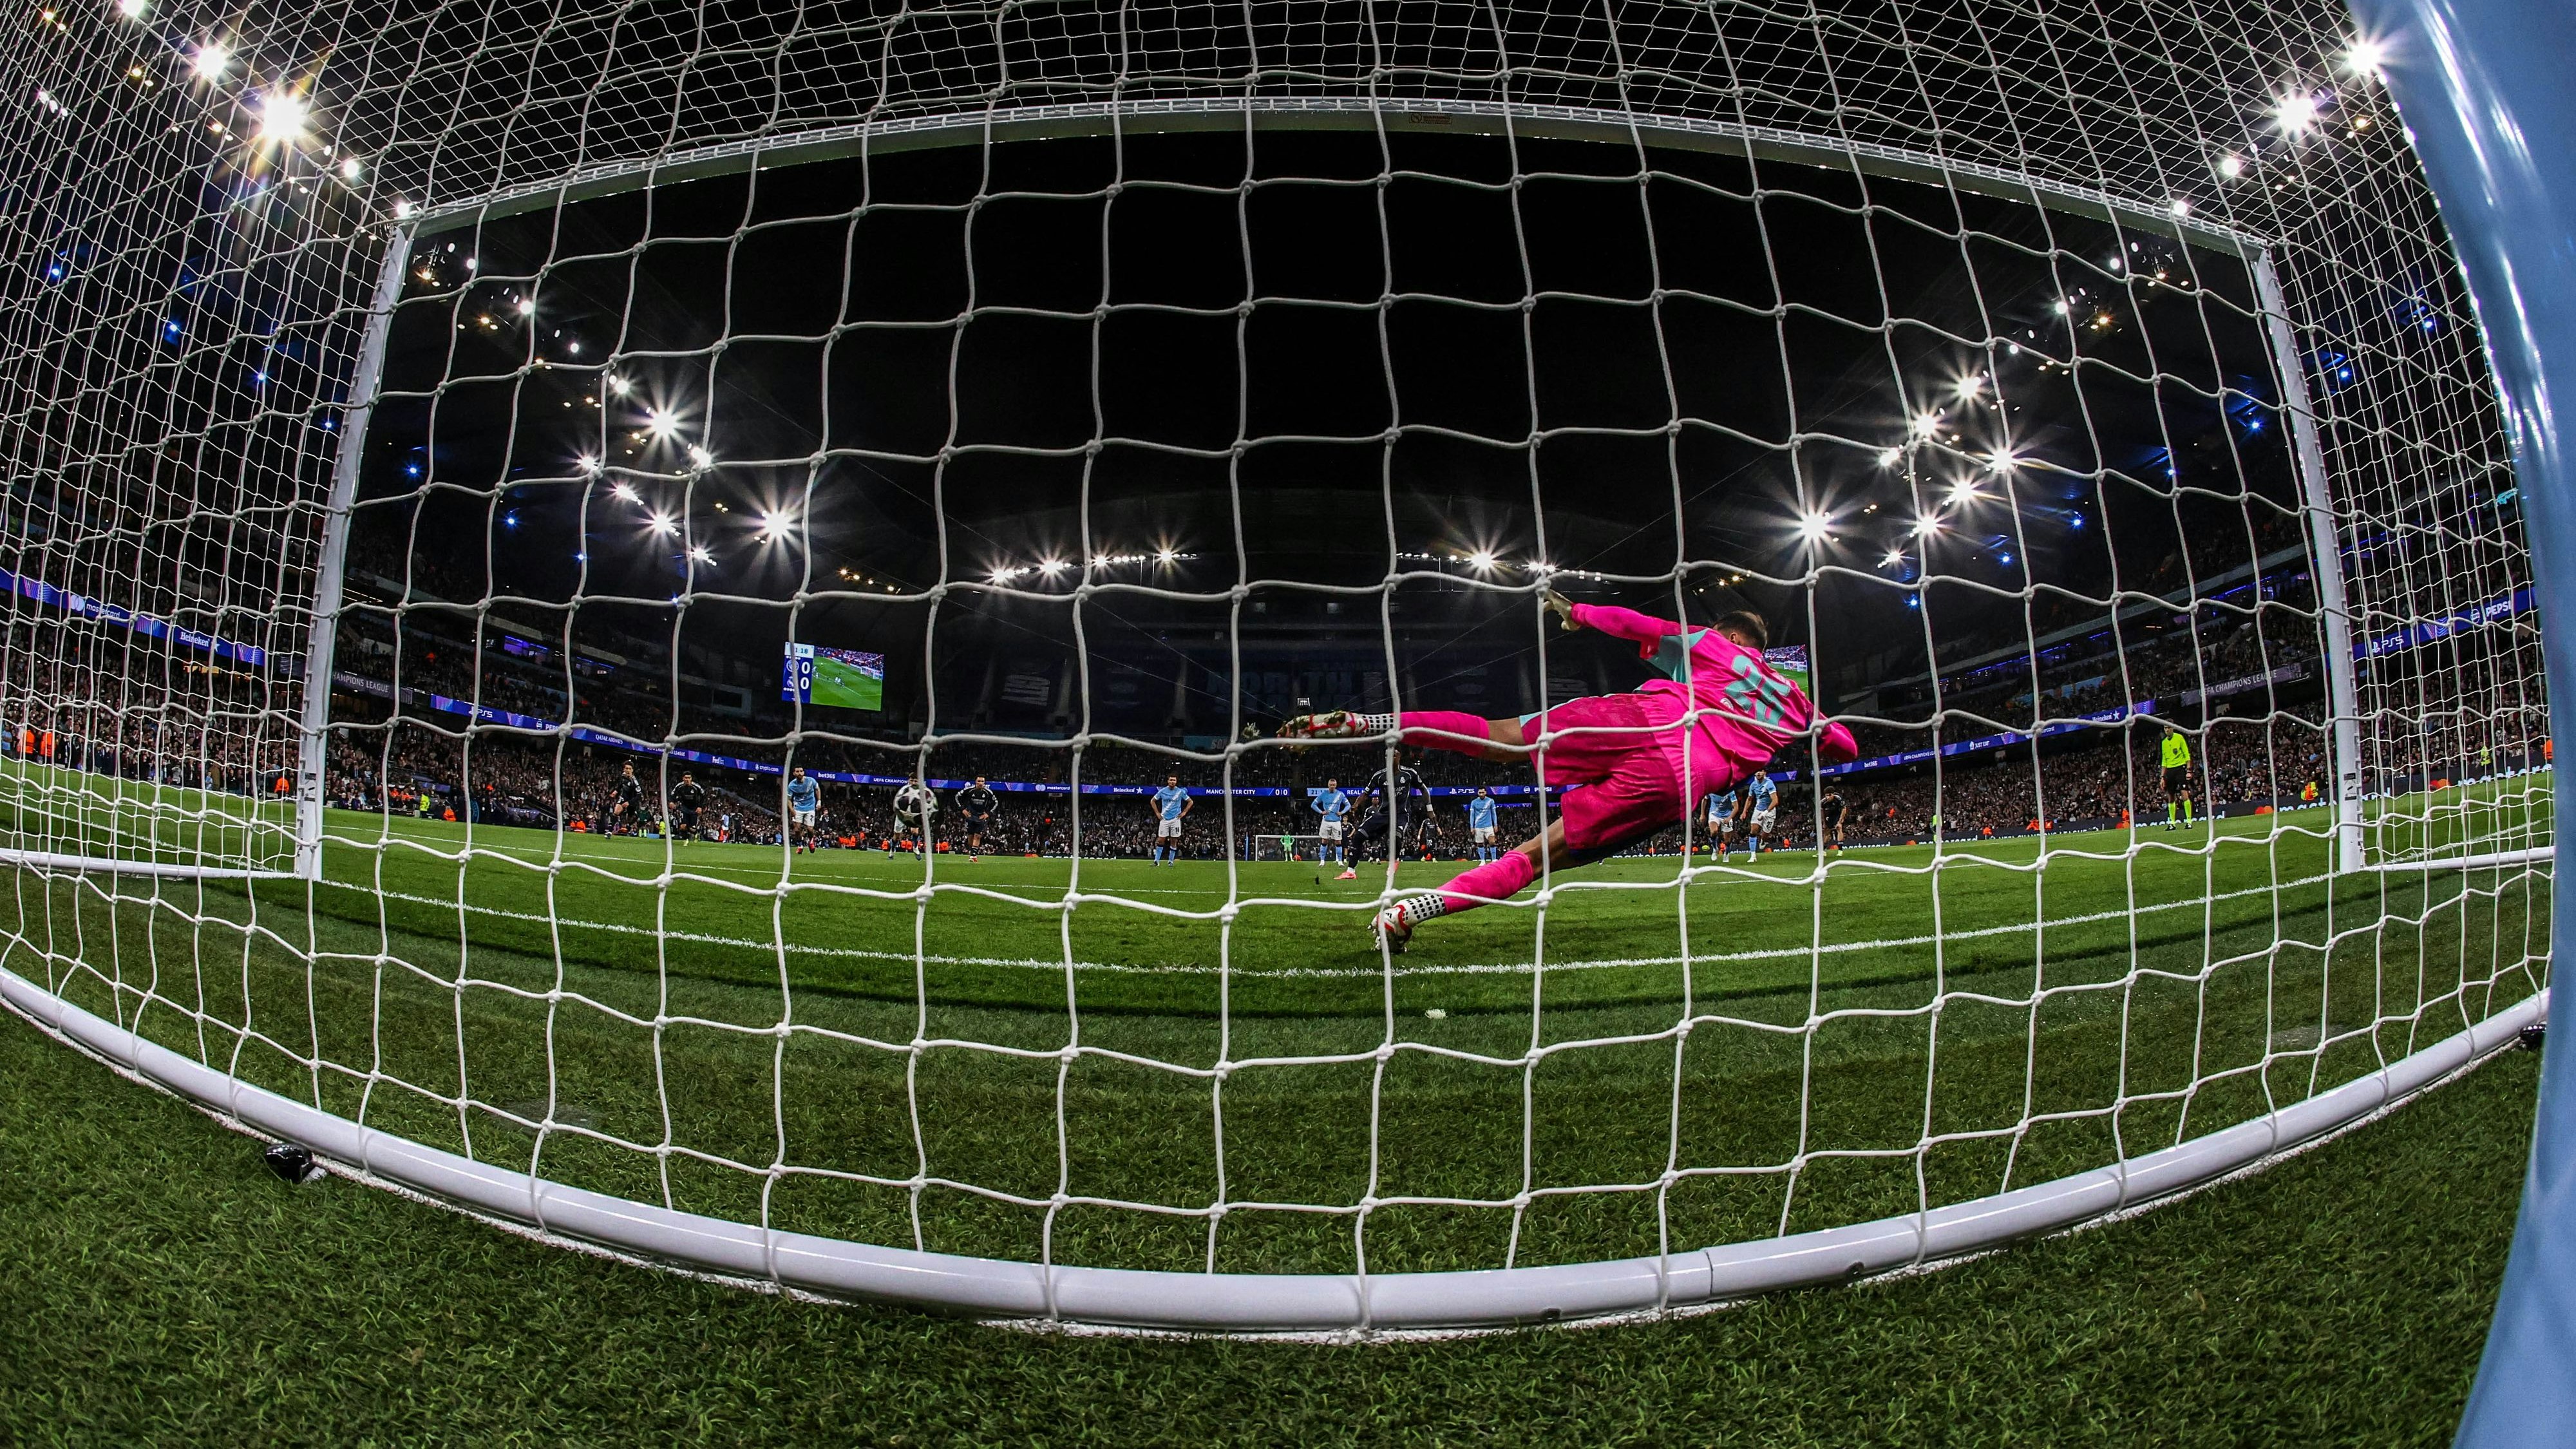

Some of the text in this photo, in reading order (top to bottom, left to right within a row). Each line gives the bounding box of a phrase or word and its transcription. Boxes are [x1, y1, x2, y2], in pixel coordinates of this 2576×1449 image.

[2485, 600, 2512, 617] PEPSI
[180, 631, 209, 647] Heineken
[2381, 635, 2404, 649] PS5
[801, 661, 811, 674] 0
[333, 671, 390, 693] HAMPIONS LEAGUE
[800, 677, 810, 690] 0
[2204, 687, 2215, 696] EFA
[2215, 676, 2251, 693] CHAMPIONS
[477, 708, 493, 718] PS5
[2457, 764, 2553, 786] masterc
[1918, 835, 1978, 845] maercard
